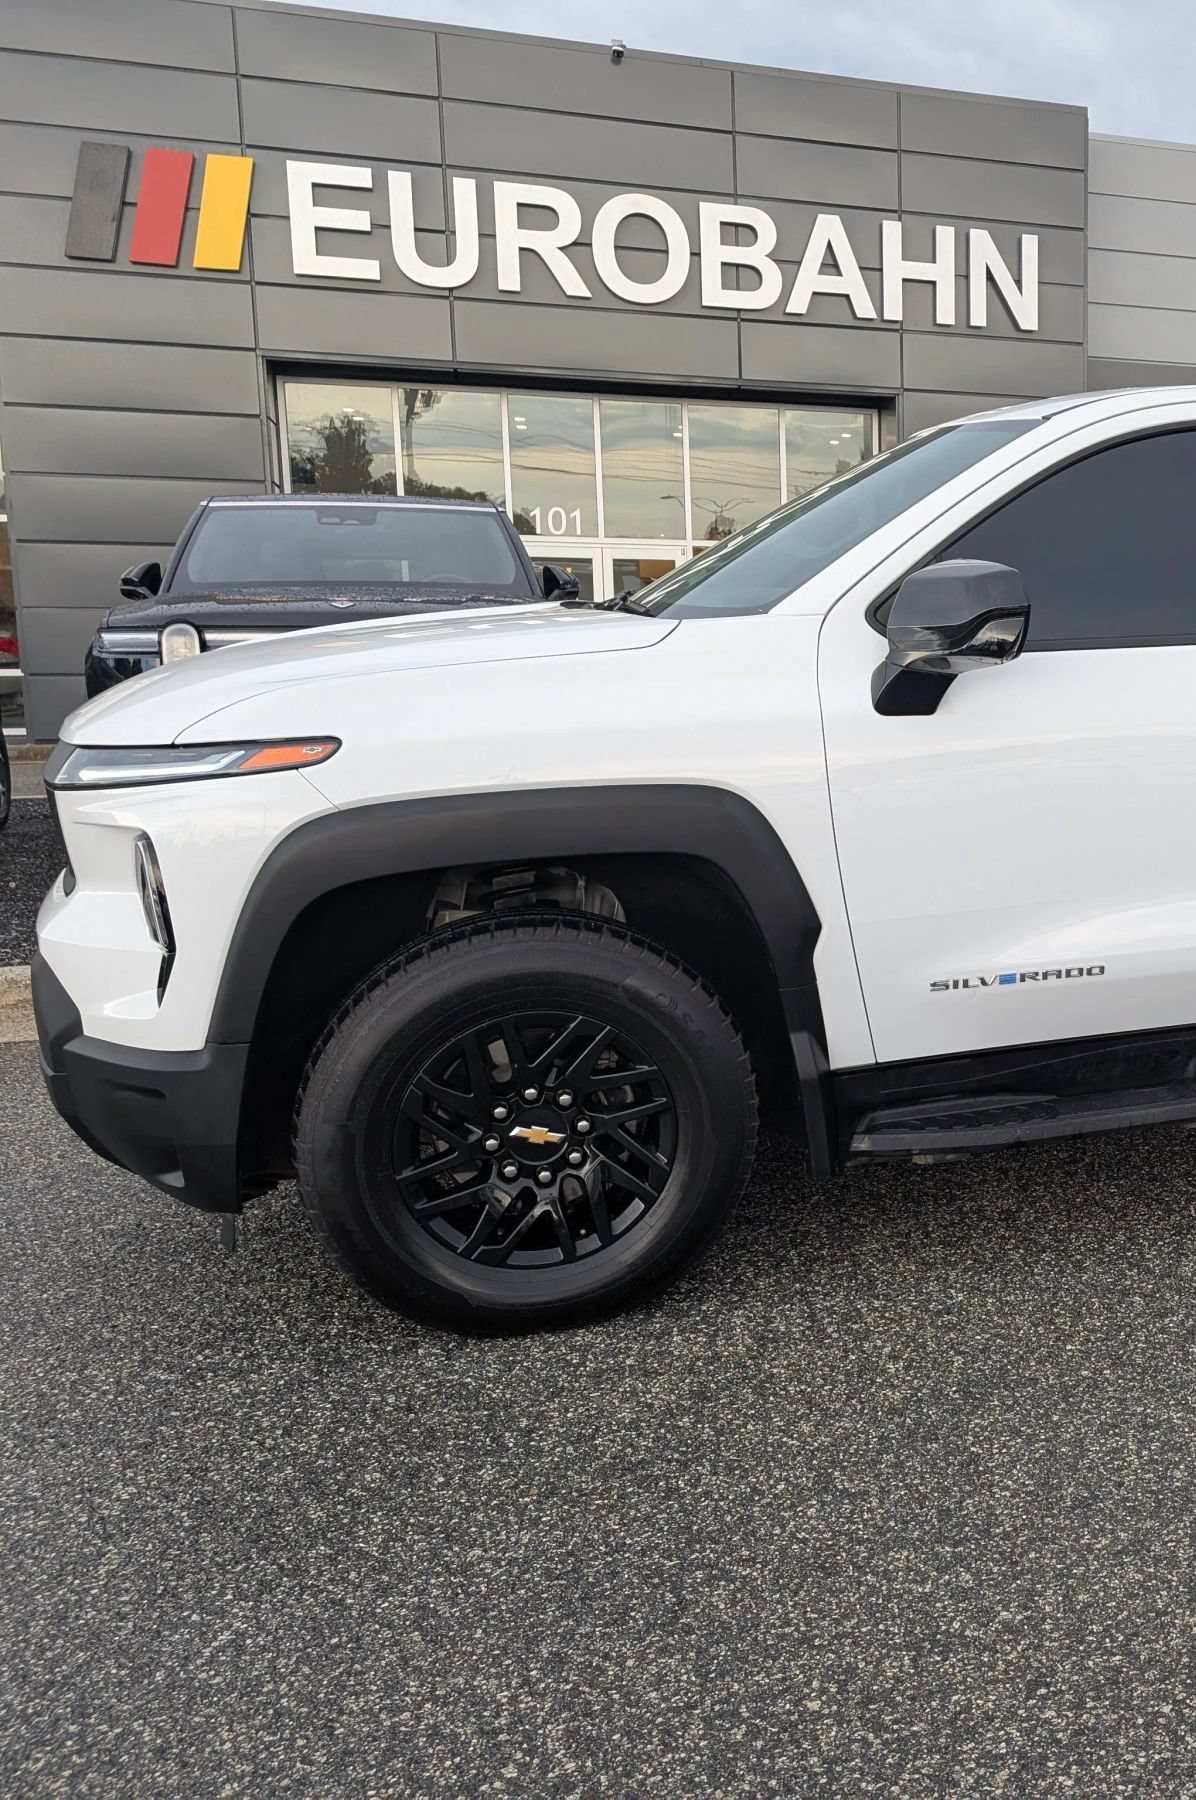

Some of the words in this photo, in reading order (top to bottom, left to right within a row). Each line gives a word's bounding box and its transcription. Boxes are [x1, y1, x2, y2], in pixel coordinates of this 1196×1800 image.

[286, 159, 1040, 332] EUROBAHN
[529, 506, 582, 536] 101
[929, 964, 1106, 992] SILVERADO
